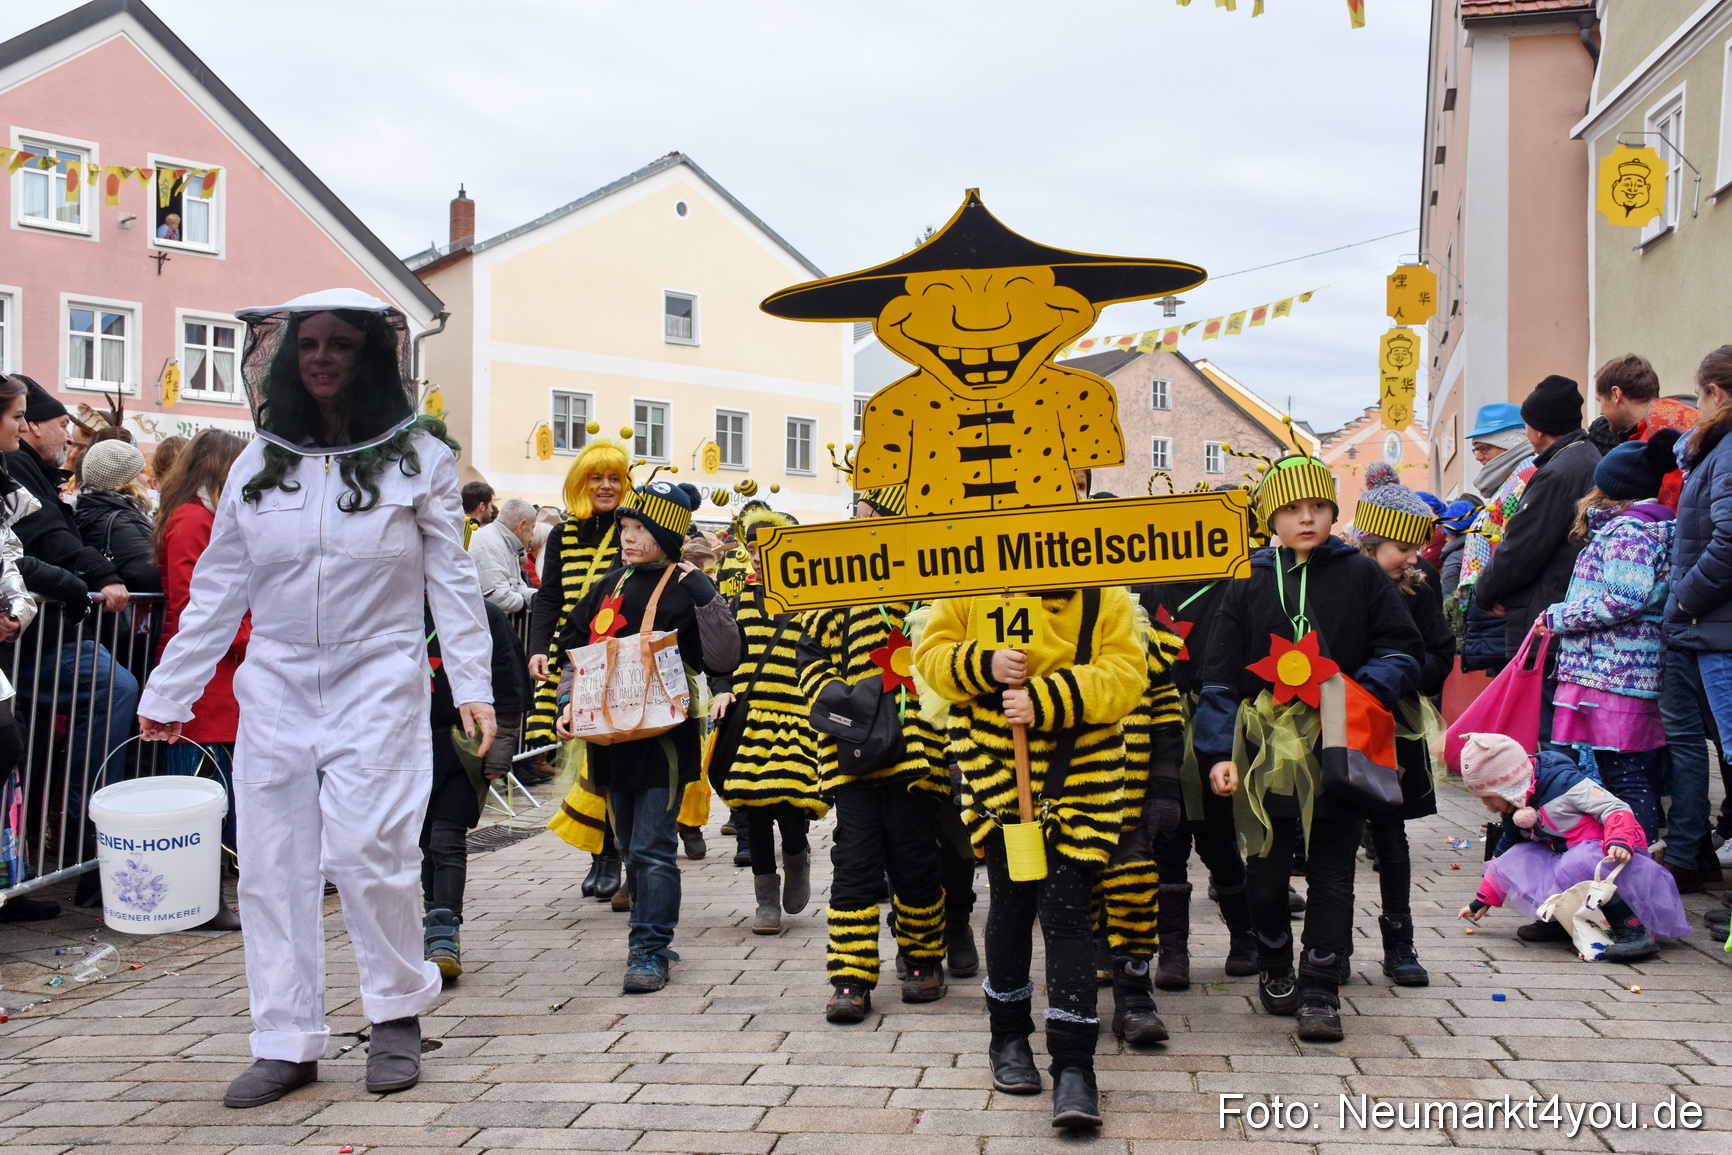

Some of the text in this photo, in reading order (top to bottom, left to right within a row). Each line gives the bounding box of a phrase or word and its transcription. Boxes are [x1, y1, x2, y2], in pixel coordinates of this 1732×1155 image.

[780, 520, 1229, 589] Grund- und Mittelschule
[986, 607, 1034, 644] 14
[109, 909, 150, 921] EIGENER
[154, 904, 200, 921] IMKEREI
